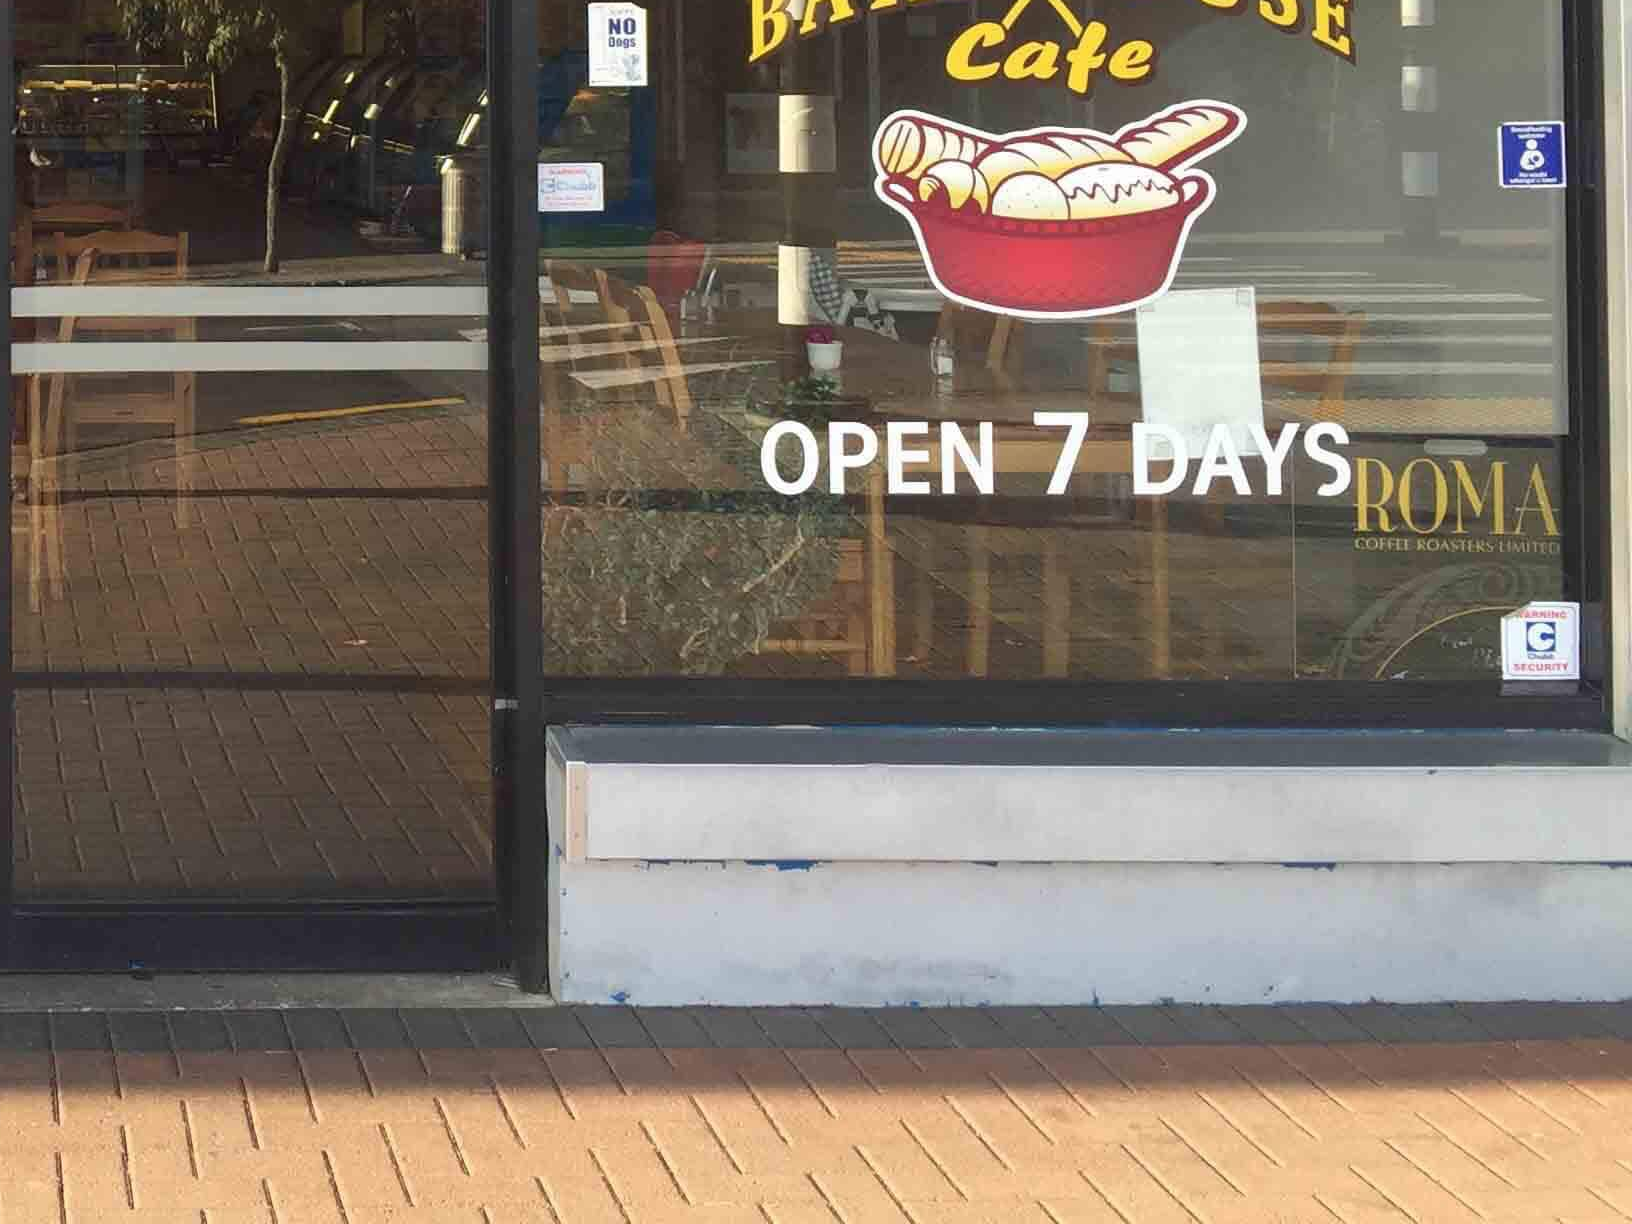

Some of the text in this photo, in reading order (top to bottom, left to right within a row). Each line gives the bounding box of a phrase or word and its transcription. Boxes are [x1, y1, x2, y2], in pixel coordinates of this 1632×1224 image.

[608, 17, 636, 35] NO
[608, 37, 636, 49] Dogs
[944, 22, 1155, 95] Cafe
[759, 412, 1352, 497] OPEN 7 DAYS
[1353, 456, 1562, 537] ROMA
[1354, 537, 1410, 551] COFFEE
[1415, 538, 1495, 553] ROASTERS
[1512, 663, 1569, 672] SECURITY
